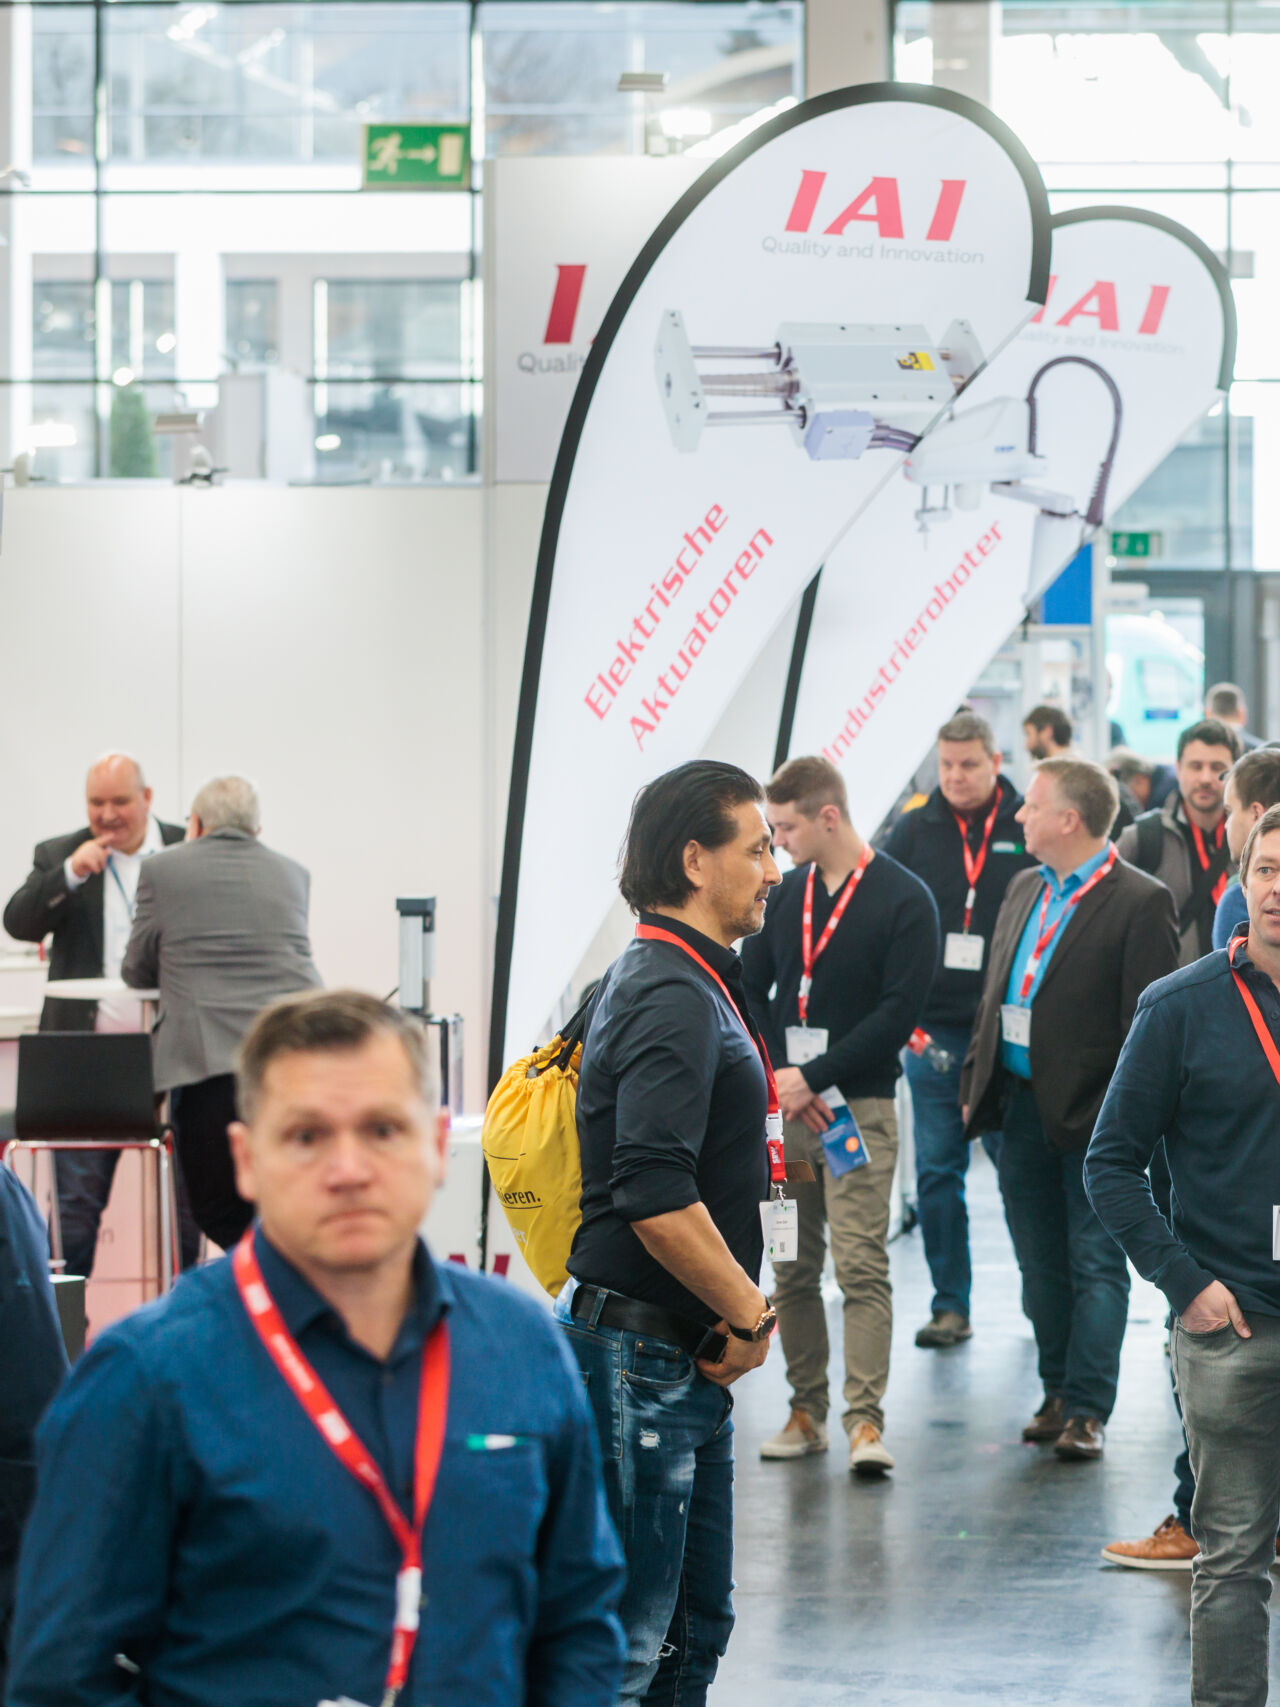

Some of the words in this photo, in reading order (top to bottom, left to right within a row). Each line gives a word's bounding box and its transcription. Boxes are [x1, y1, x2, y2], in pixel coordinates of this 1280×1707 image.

[761, 236, 830, 259] Quality
[837, 243, 873, 259] and
[880, 244, 985, 264] Innovation
[784, 169, 967, 242] IAI
[584, 503, 729, 720] Elektrische
[629, 528, 774, 752] Aktuatoren
[821, 520, 1003, 766] Industrieroboter
